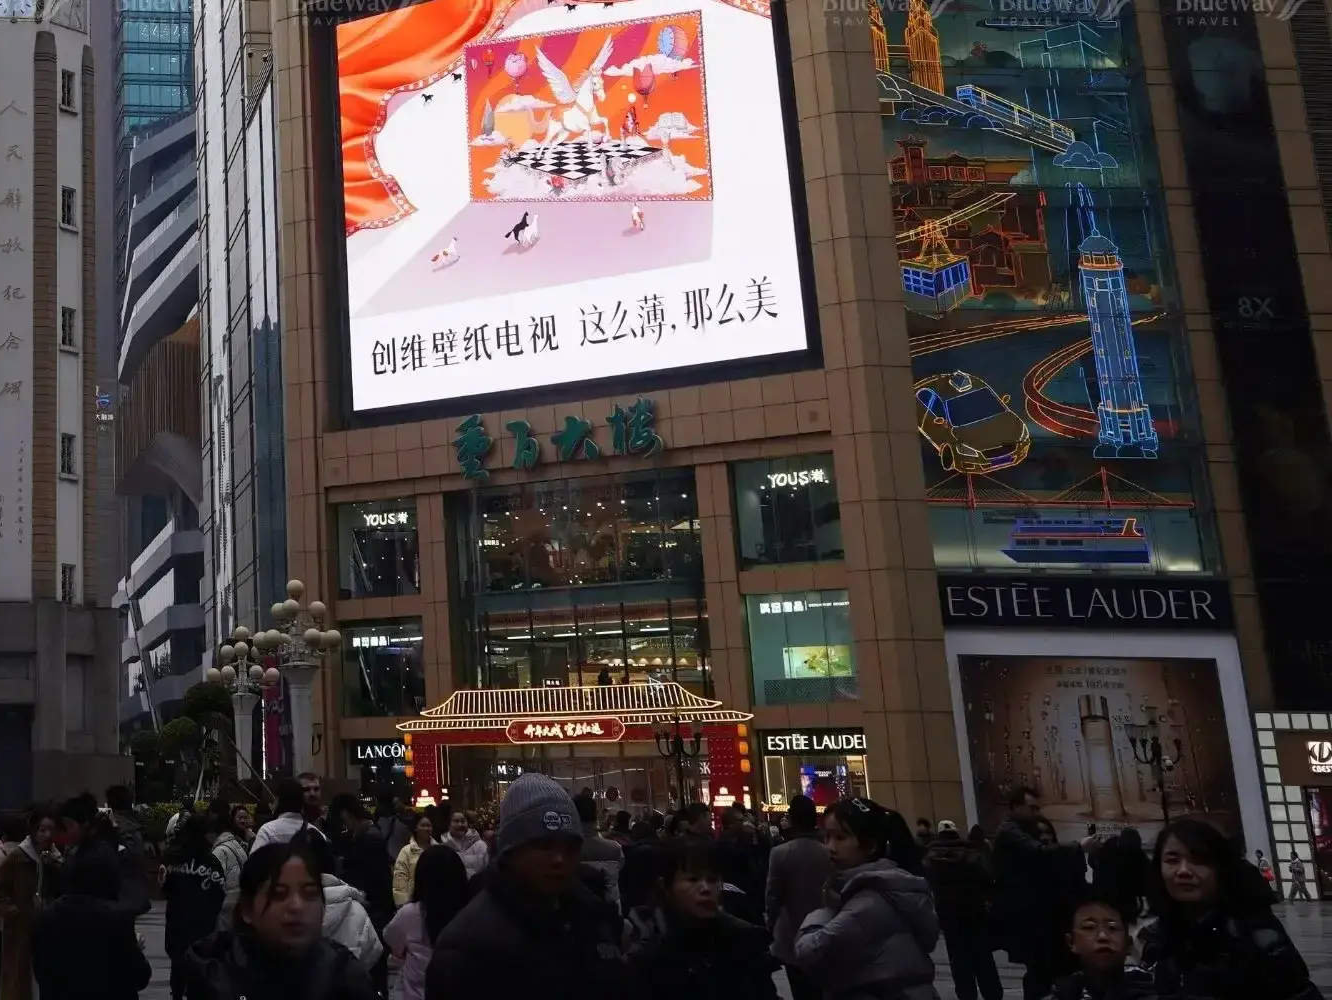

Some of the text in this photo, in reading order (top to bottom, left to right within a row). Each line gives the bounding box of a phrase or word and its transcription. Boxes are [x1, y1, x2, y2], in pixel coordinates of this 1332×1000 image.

[371, 314, 559, 376] 创维壁纸电视
[453, 394, 665, 480] 重百大楼
[1065, 587, 1217, 621] LAUDER
